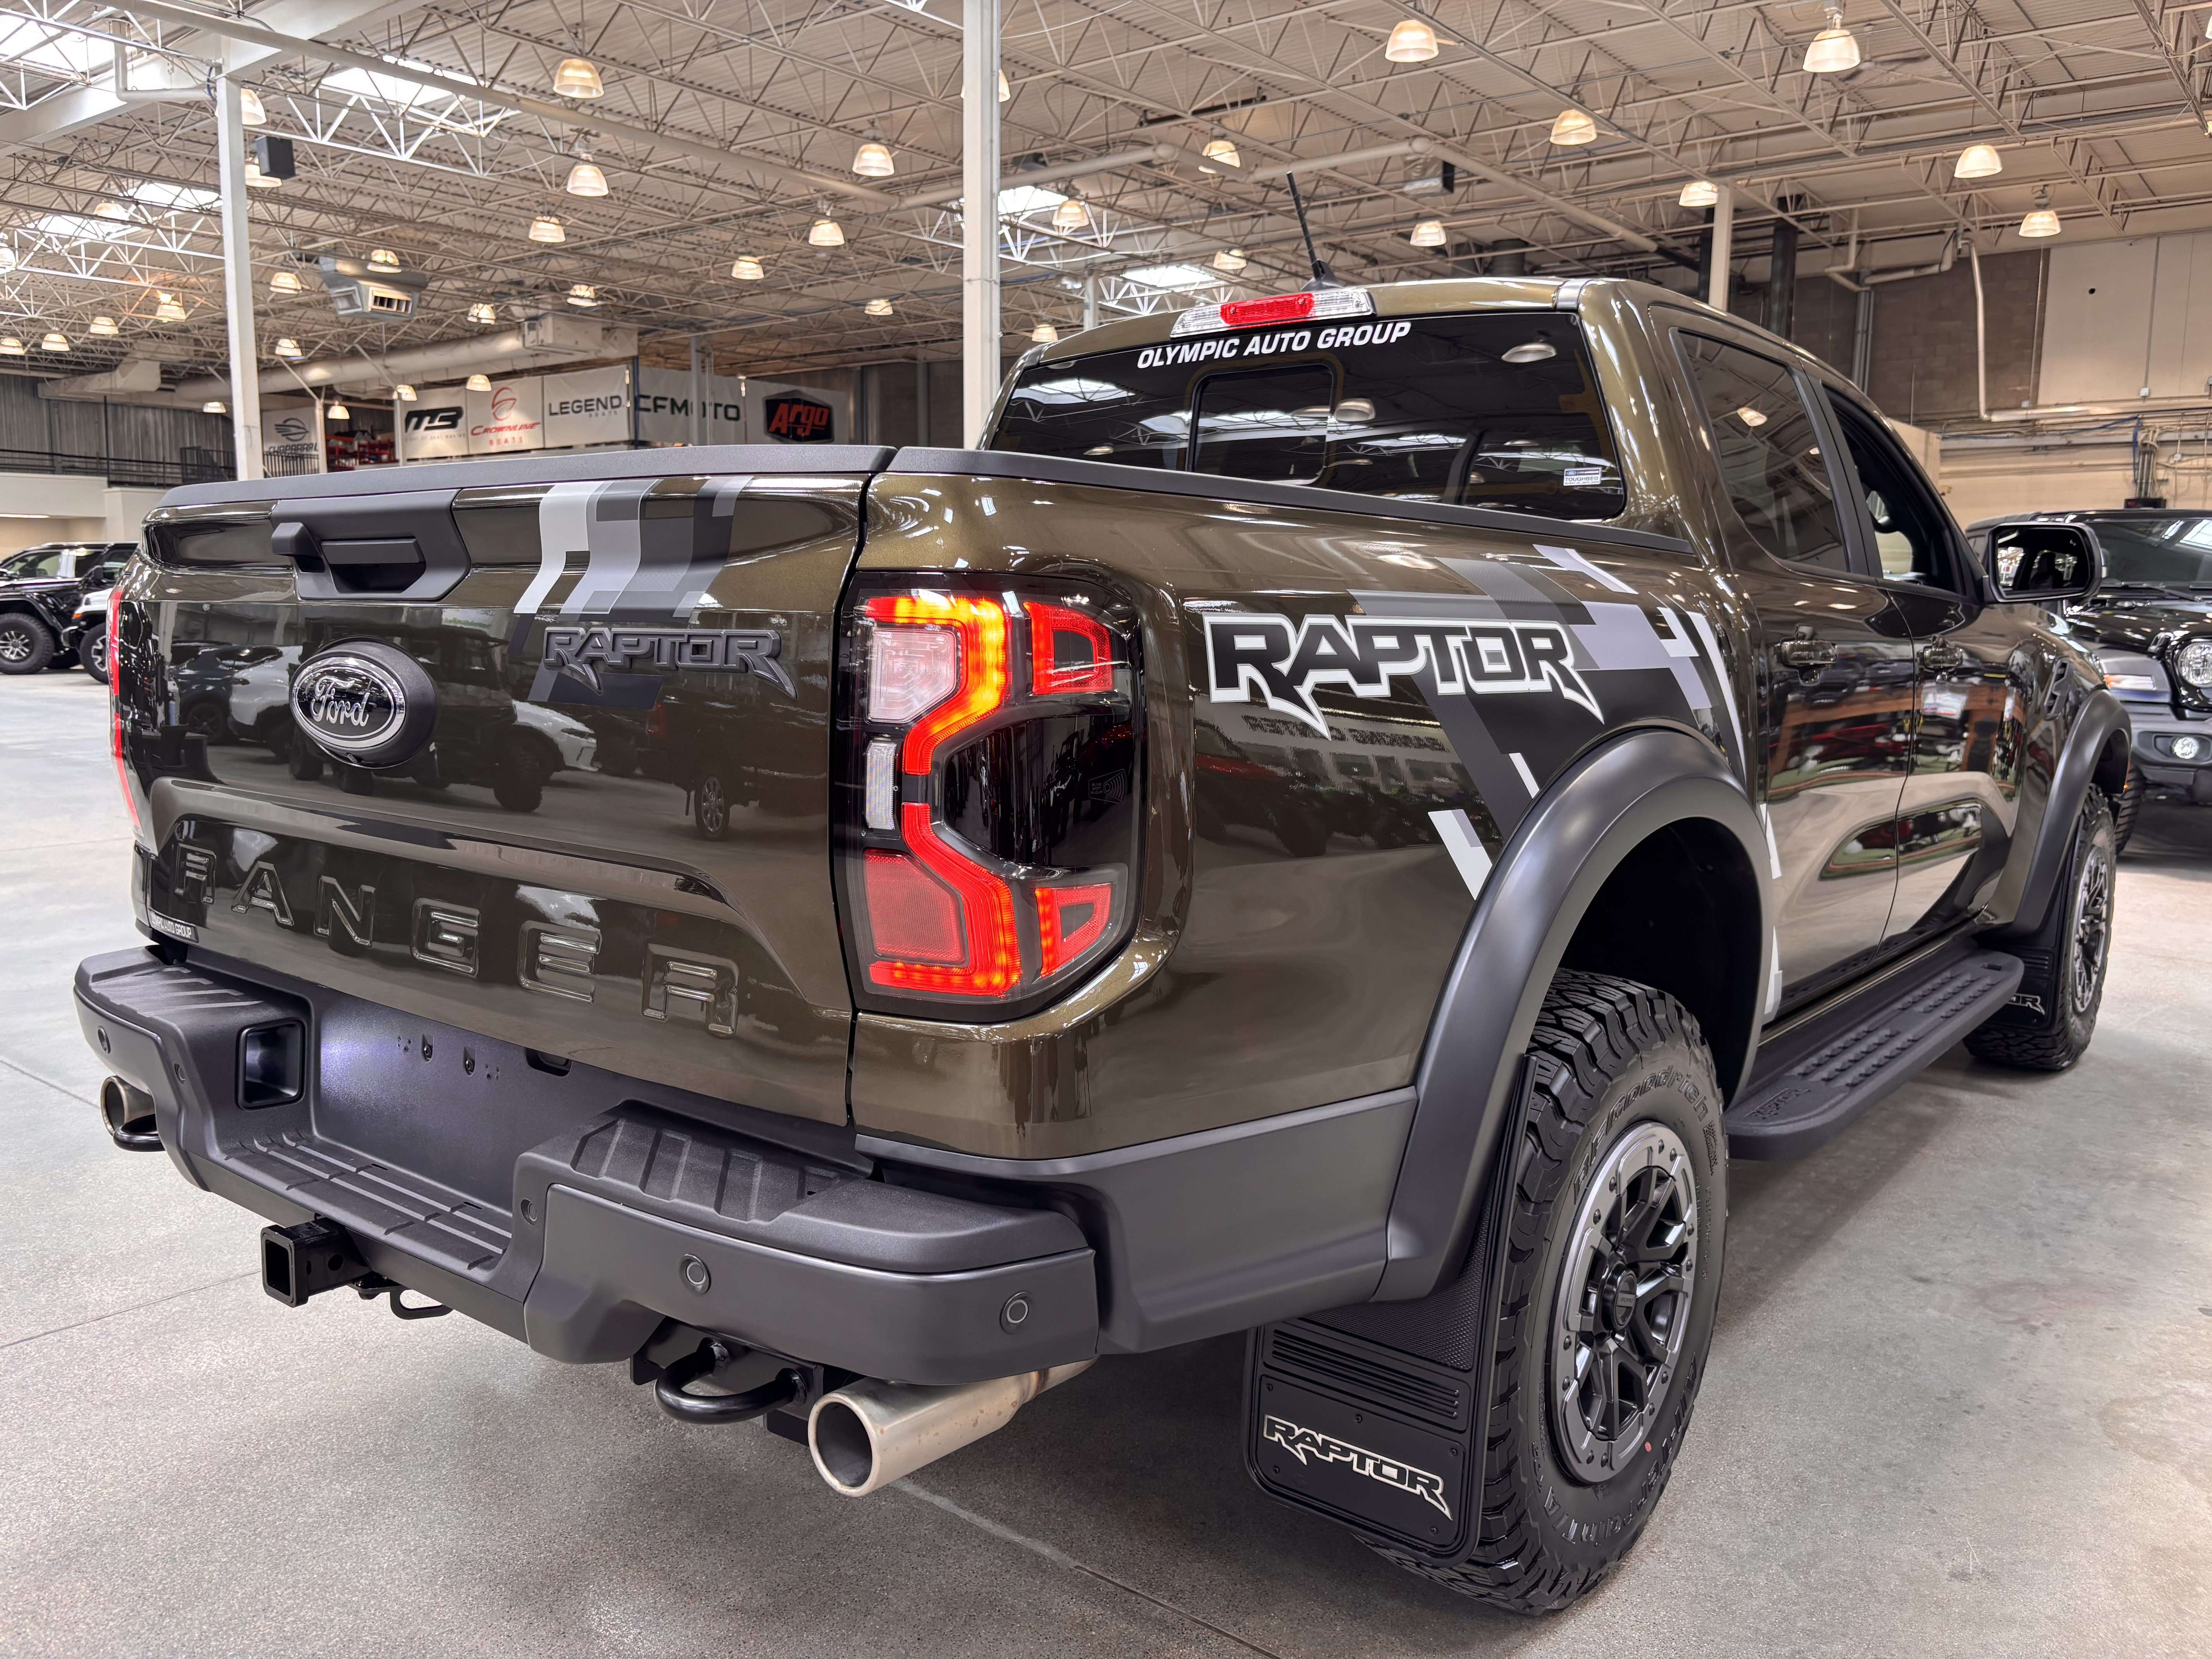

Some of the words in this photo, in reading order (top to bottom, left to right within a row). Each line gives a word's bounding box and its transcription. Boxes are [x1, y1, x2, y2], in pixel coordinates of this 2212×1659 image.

[1137, 338, 1240, 369] OLYMPIC
[1243, 331, 1311, 356] AUTO
[1317, 322, 1411, 349] GROUP
[549, 395, 622, 416] LEGEND
[768, 402, 830, 436] Argo
[543, 627, 798, 698] RAPTOR
[1202, 613, 1605, 741] RAPTOR
[311, 676, 371, 727] Ford
[173, 843, 739, 1037] RANGER
[175, 923, 192, 938] GROUP
[1263, 1413, 1453, 1521] RAPTOR
